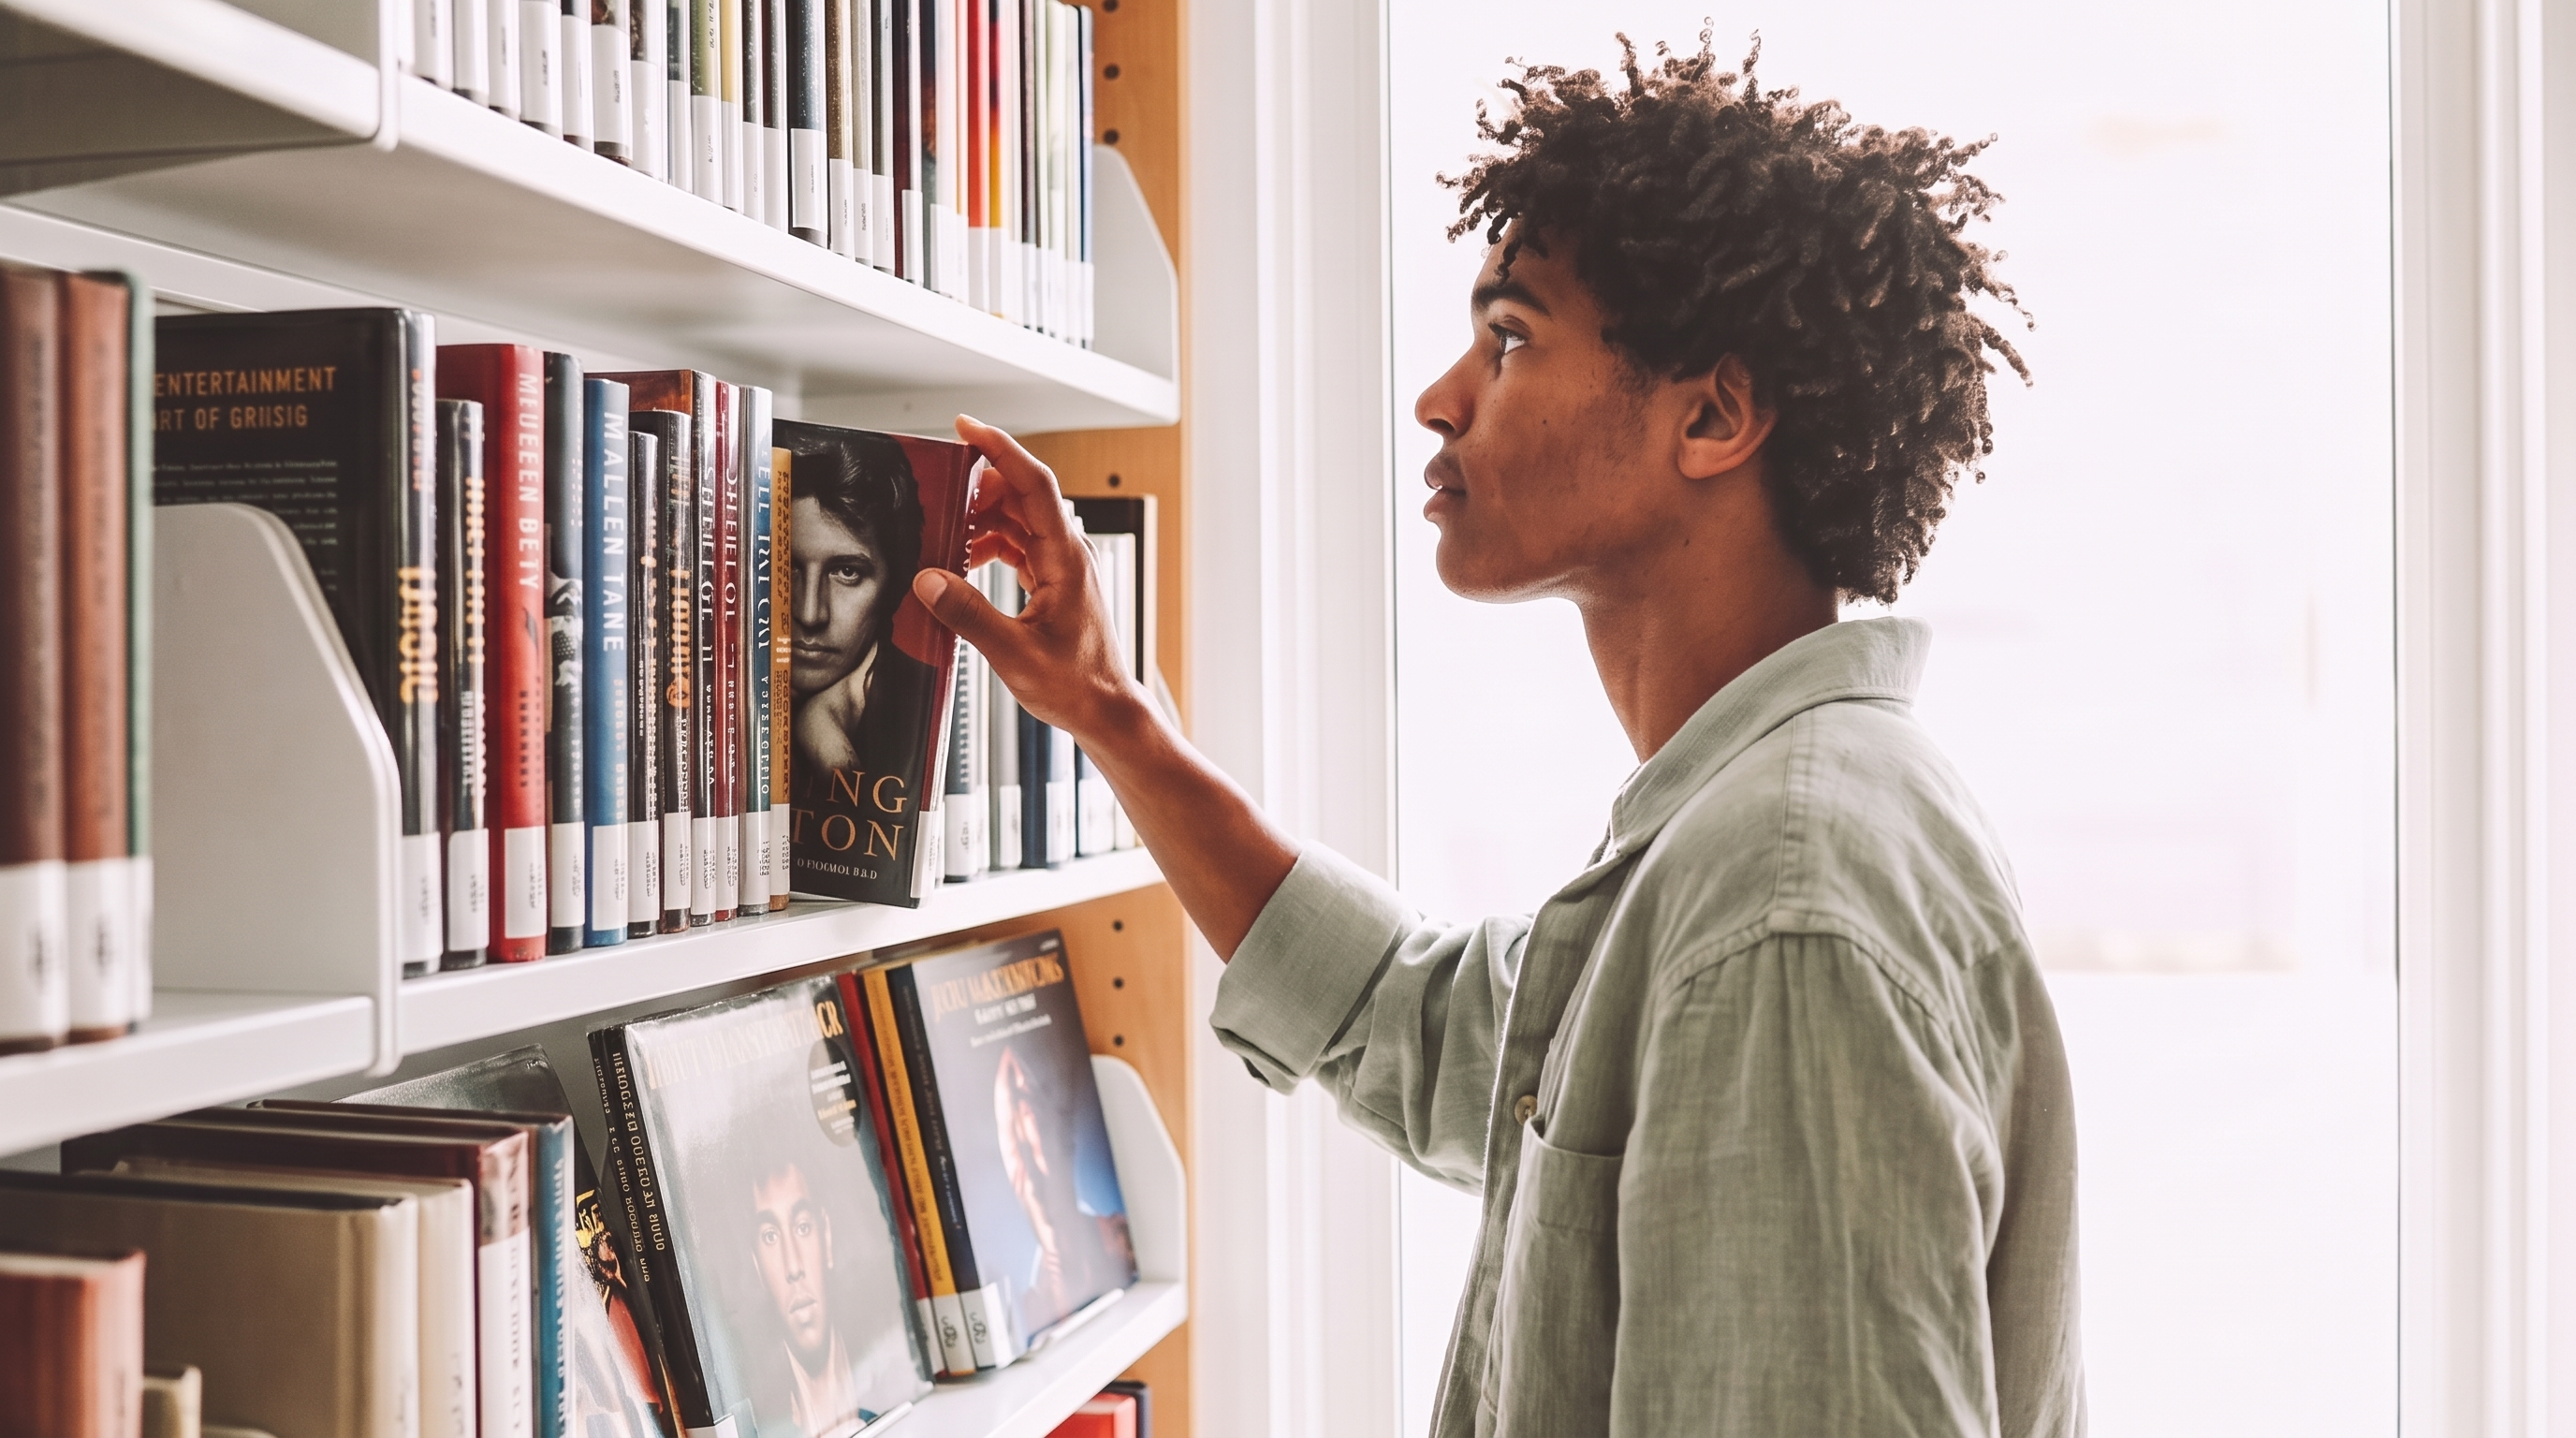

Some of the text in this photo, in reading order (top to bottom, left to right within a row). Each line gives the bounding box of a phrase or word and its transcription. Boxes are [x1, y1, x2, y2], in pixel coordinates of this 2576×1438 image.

[155, 366, 336, 397] ENTERTAINMENT
[153, 408, 184, 431] RT
[195, 406, 220, 430] OF
[604, 412, 624, 555] MALLEN
[603, 572, 624, 652] TANE
[808, 768, 908, 814] NG
[791, 808, 904, 861] TON
